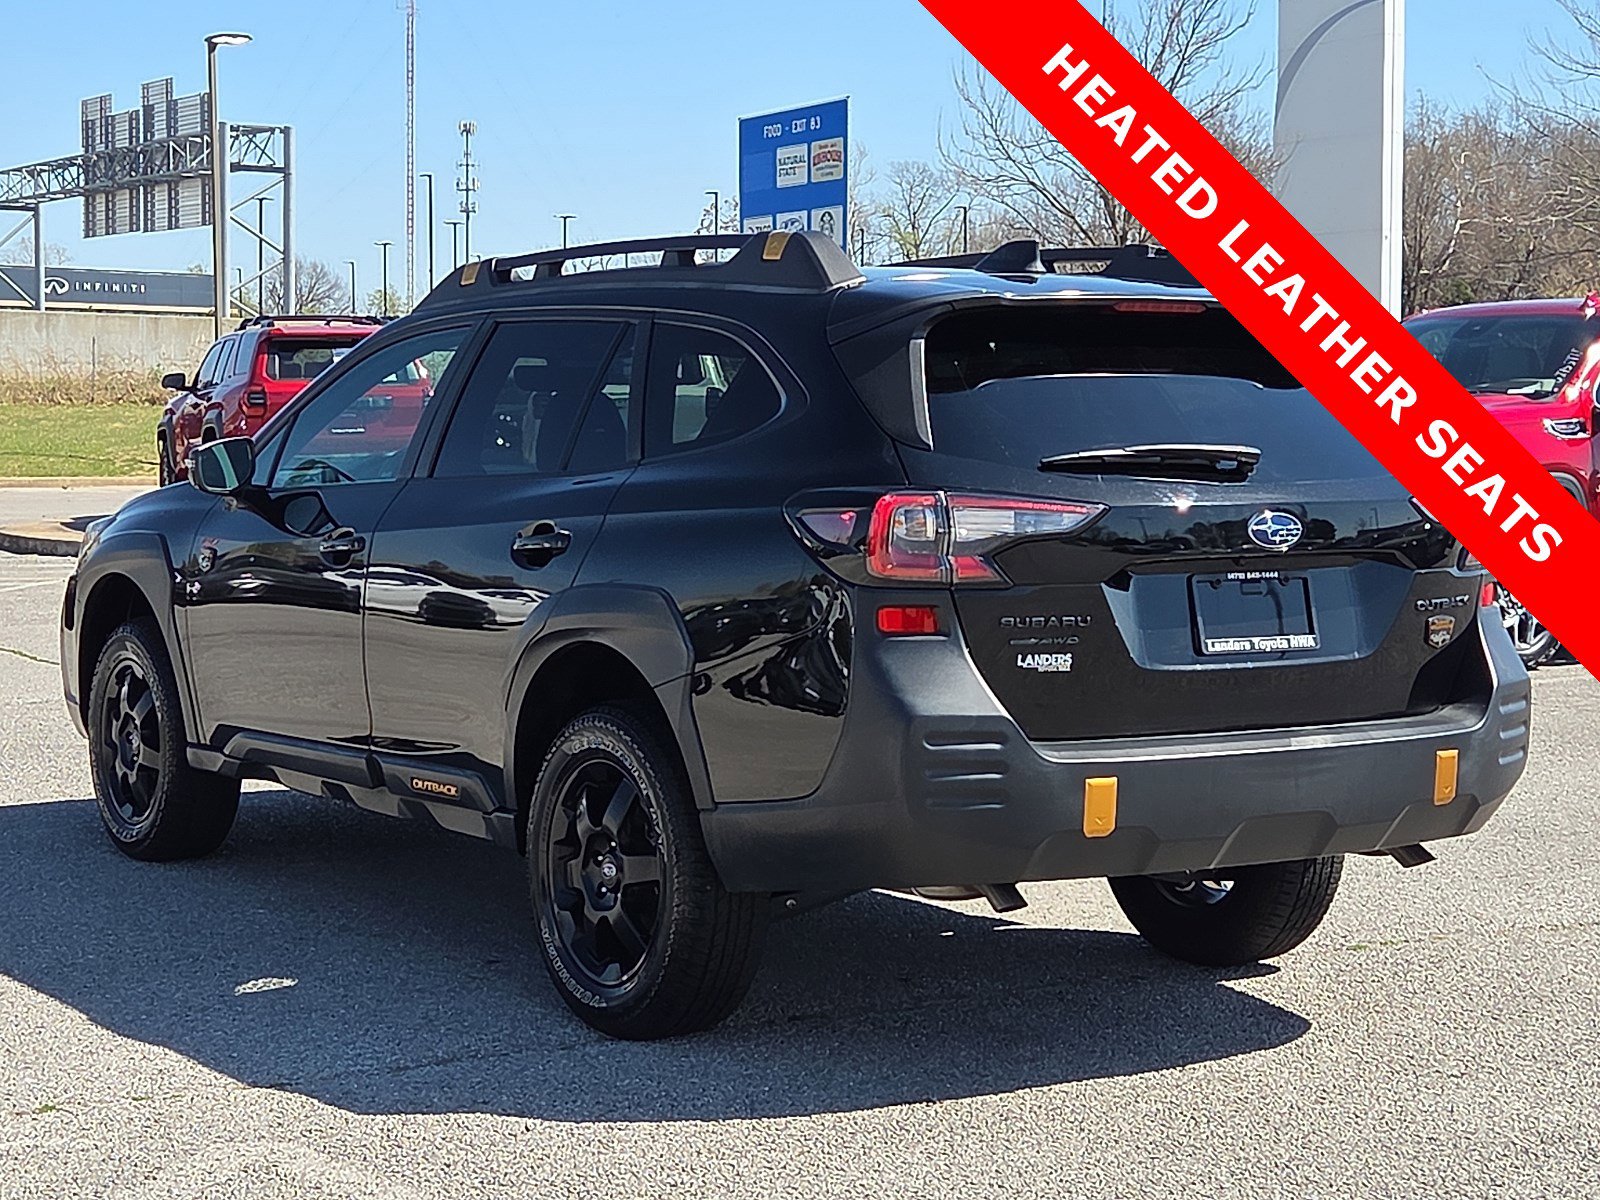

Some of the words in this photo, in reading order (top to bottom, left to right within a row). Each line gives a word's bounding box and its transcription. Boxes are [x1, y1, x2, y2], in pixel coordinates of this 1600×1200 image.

[763, 123, 782, 139] FOOD
[792, 118, 806, 133] EXIT
[778, 154, 806, 167] NATURAL
[778, 166, 797, 178] STATE
[75, 281, 146, 293] INFINITI
[1416, 595, 1469, 611] OUTBACK
[1000, 615, 1091, 628] SUBARU
[1038, 636, 1080, 645] AWD
[1206, 639, 1251, 652] Landers
[1253, 637, 1289, 652] Toyota
[1017, 652, 1073, 667] LANDERS
[412, 778, 459, 796] OUTBACK
